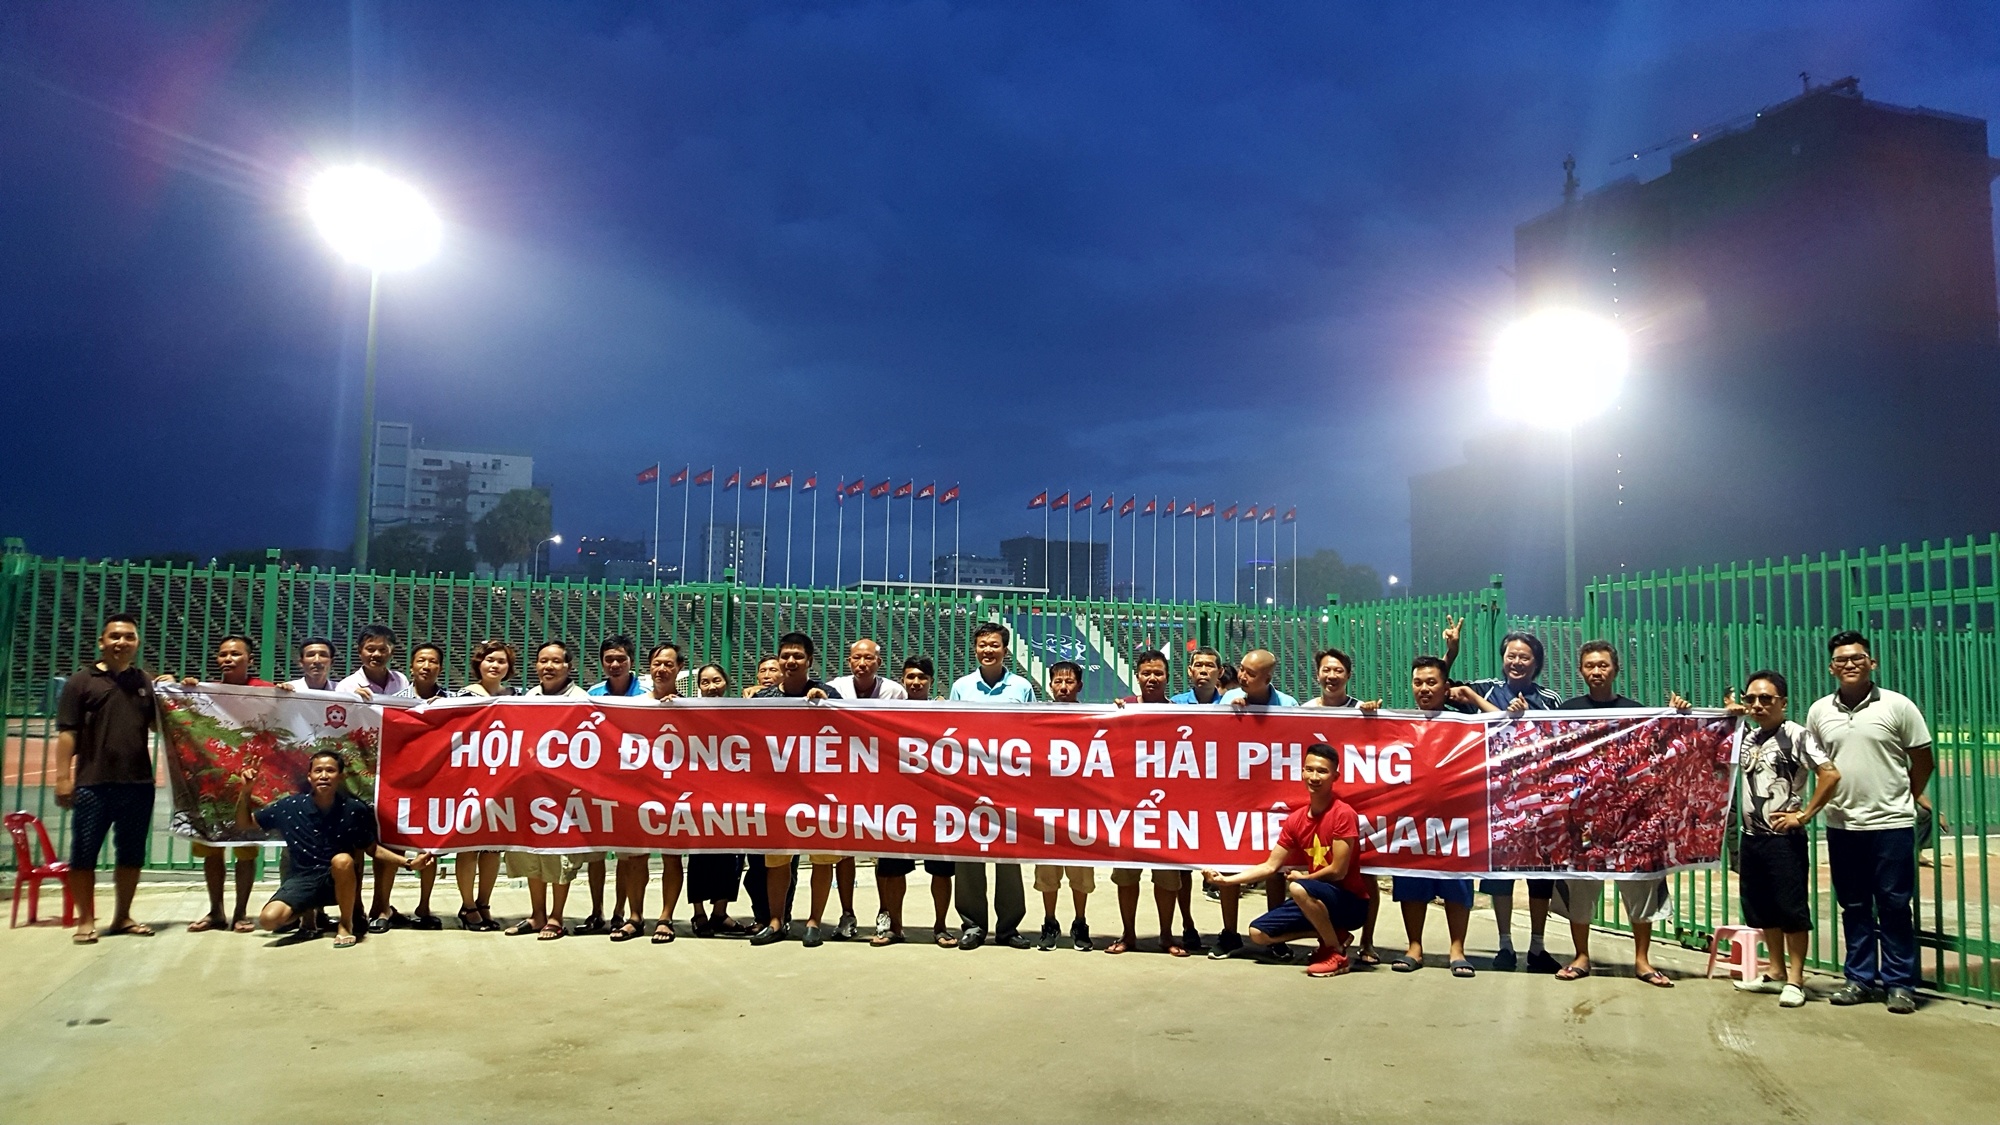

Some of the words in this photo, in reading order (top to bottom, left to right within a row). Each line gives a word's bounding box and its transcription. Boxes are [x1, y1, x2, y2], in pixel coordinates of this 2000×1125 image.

[451, 720, 523, 775] HỘI
[536, 711, 606, 769] CỔ
[618, 723, 751, 779] ĐỘNG
[766, 725, 879, 773] VIÊN
[898, 727, 1031, 776] BÓNG
[1047, 729, 1114, 778] ĐÁ
[1135, 726, 1218, 779] HẢI
[1238, 733, 1412, 784] PHNG
[397, 787, 517, 835] LUÔN
[530, 789, 619, 835] SÁT
[638, 791, 768, 837] CÁNH
[785, 793, 917, 842] CÙNG
[933, 796, 1018, 852] ĐỘI
[1033, 789, 1199, 850] TUYỂN
[1358, 815, 1471, 858] NAM
